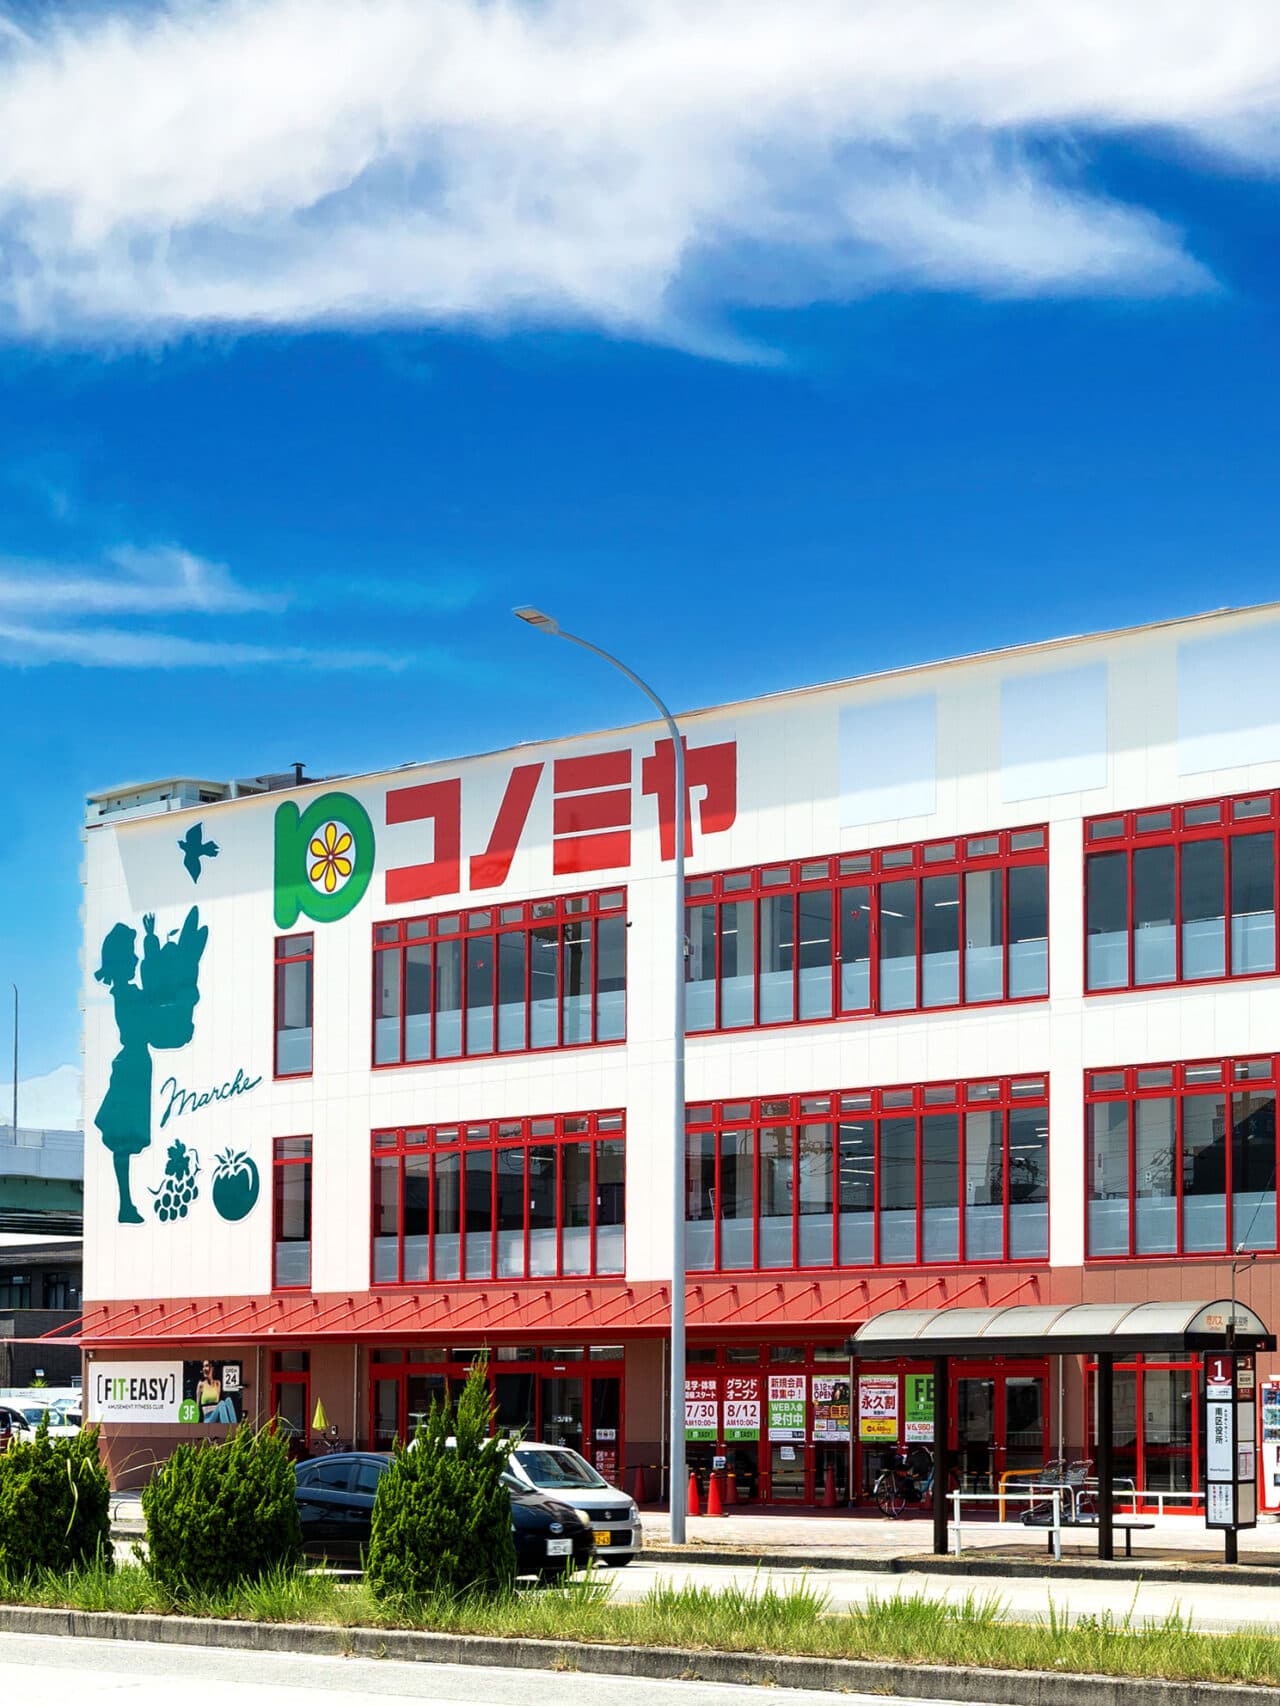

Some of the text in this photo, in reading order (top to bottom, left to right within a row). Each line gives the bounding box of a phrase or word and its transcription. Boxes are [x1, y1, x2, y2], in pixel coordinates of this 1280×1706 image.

[385, 735, 737, 905] コノミヤ
[160, 1068, 262, 1129] Marche
[1214, 1360, 1226, 1381] 1
[225, 1373, 237, 1385] 24
[727, 1379, 757, 1389] グランド
[727, 1390, 757, 1399] オープン
[814, 1391, 832, 1399] OPEN
[771, 1402, 803, 1411] WEB入会
[861, 1394, 896, 1410] 永久割
[183, 1405, 194, 1421] 3F
[686, 1404, 714, 1417] 7/30
[728, 1404, 757, 1417] 8/12
[771, 1412, 803, 1427] 受付中
